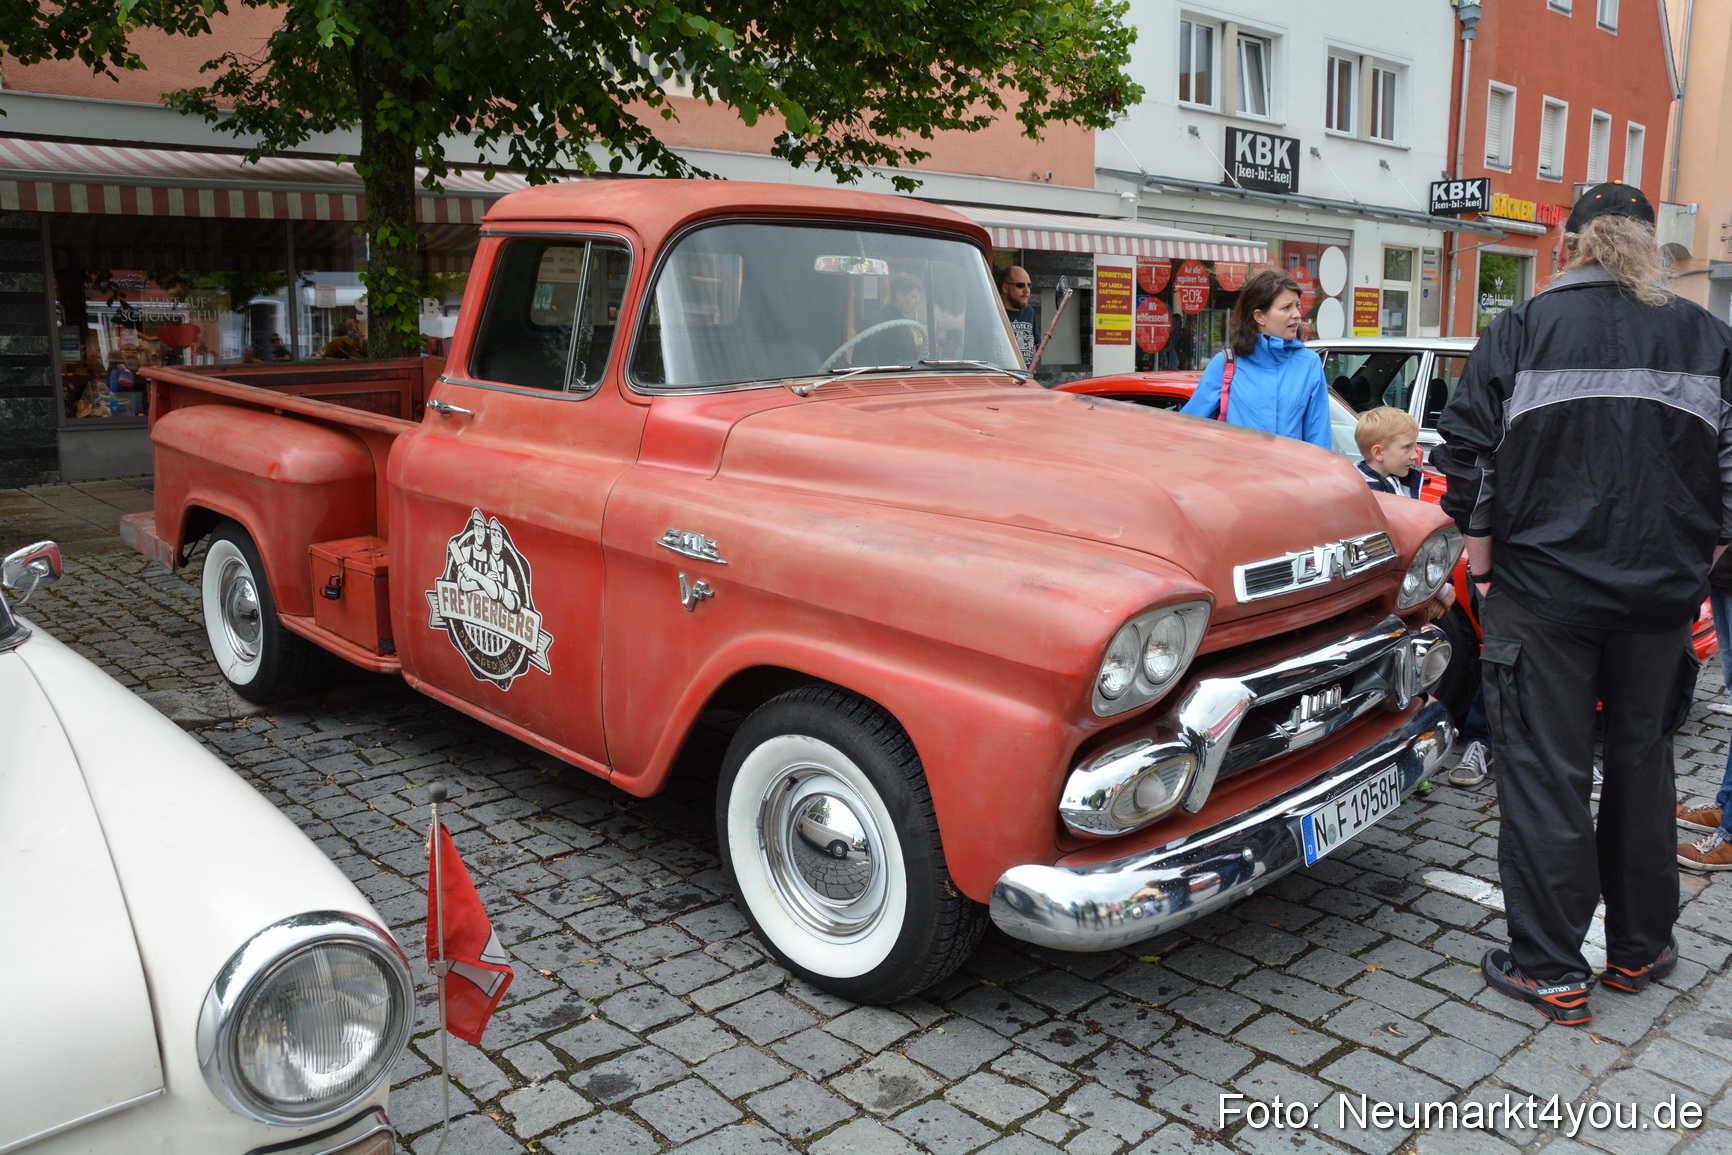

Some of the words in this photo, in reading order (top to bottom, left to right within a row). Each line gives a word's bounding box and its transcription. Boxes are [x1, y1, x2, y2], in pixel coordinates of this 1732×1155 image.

[1235, 131, 1292, 170] KBK
[1432, 180, 1482, 200] KBK
[1493, 192, 1535, 221] BÄCKER
[1097, 271, 1132, 279] VERMIETUNG
[1365, 275, 1369, 284] 5
[1182, 289, 1203, 303] 20%
[441, 586, 535, 643] FREYBERGERS
[475, 653, 497, 670] AGED
[498, 647, 517, 667] BEEF
